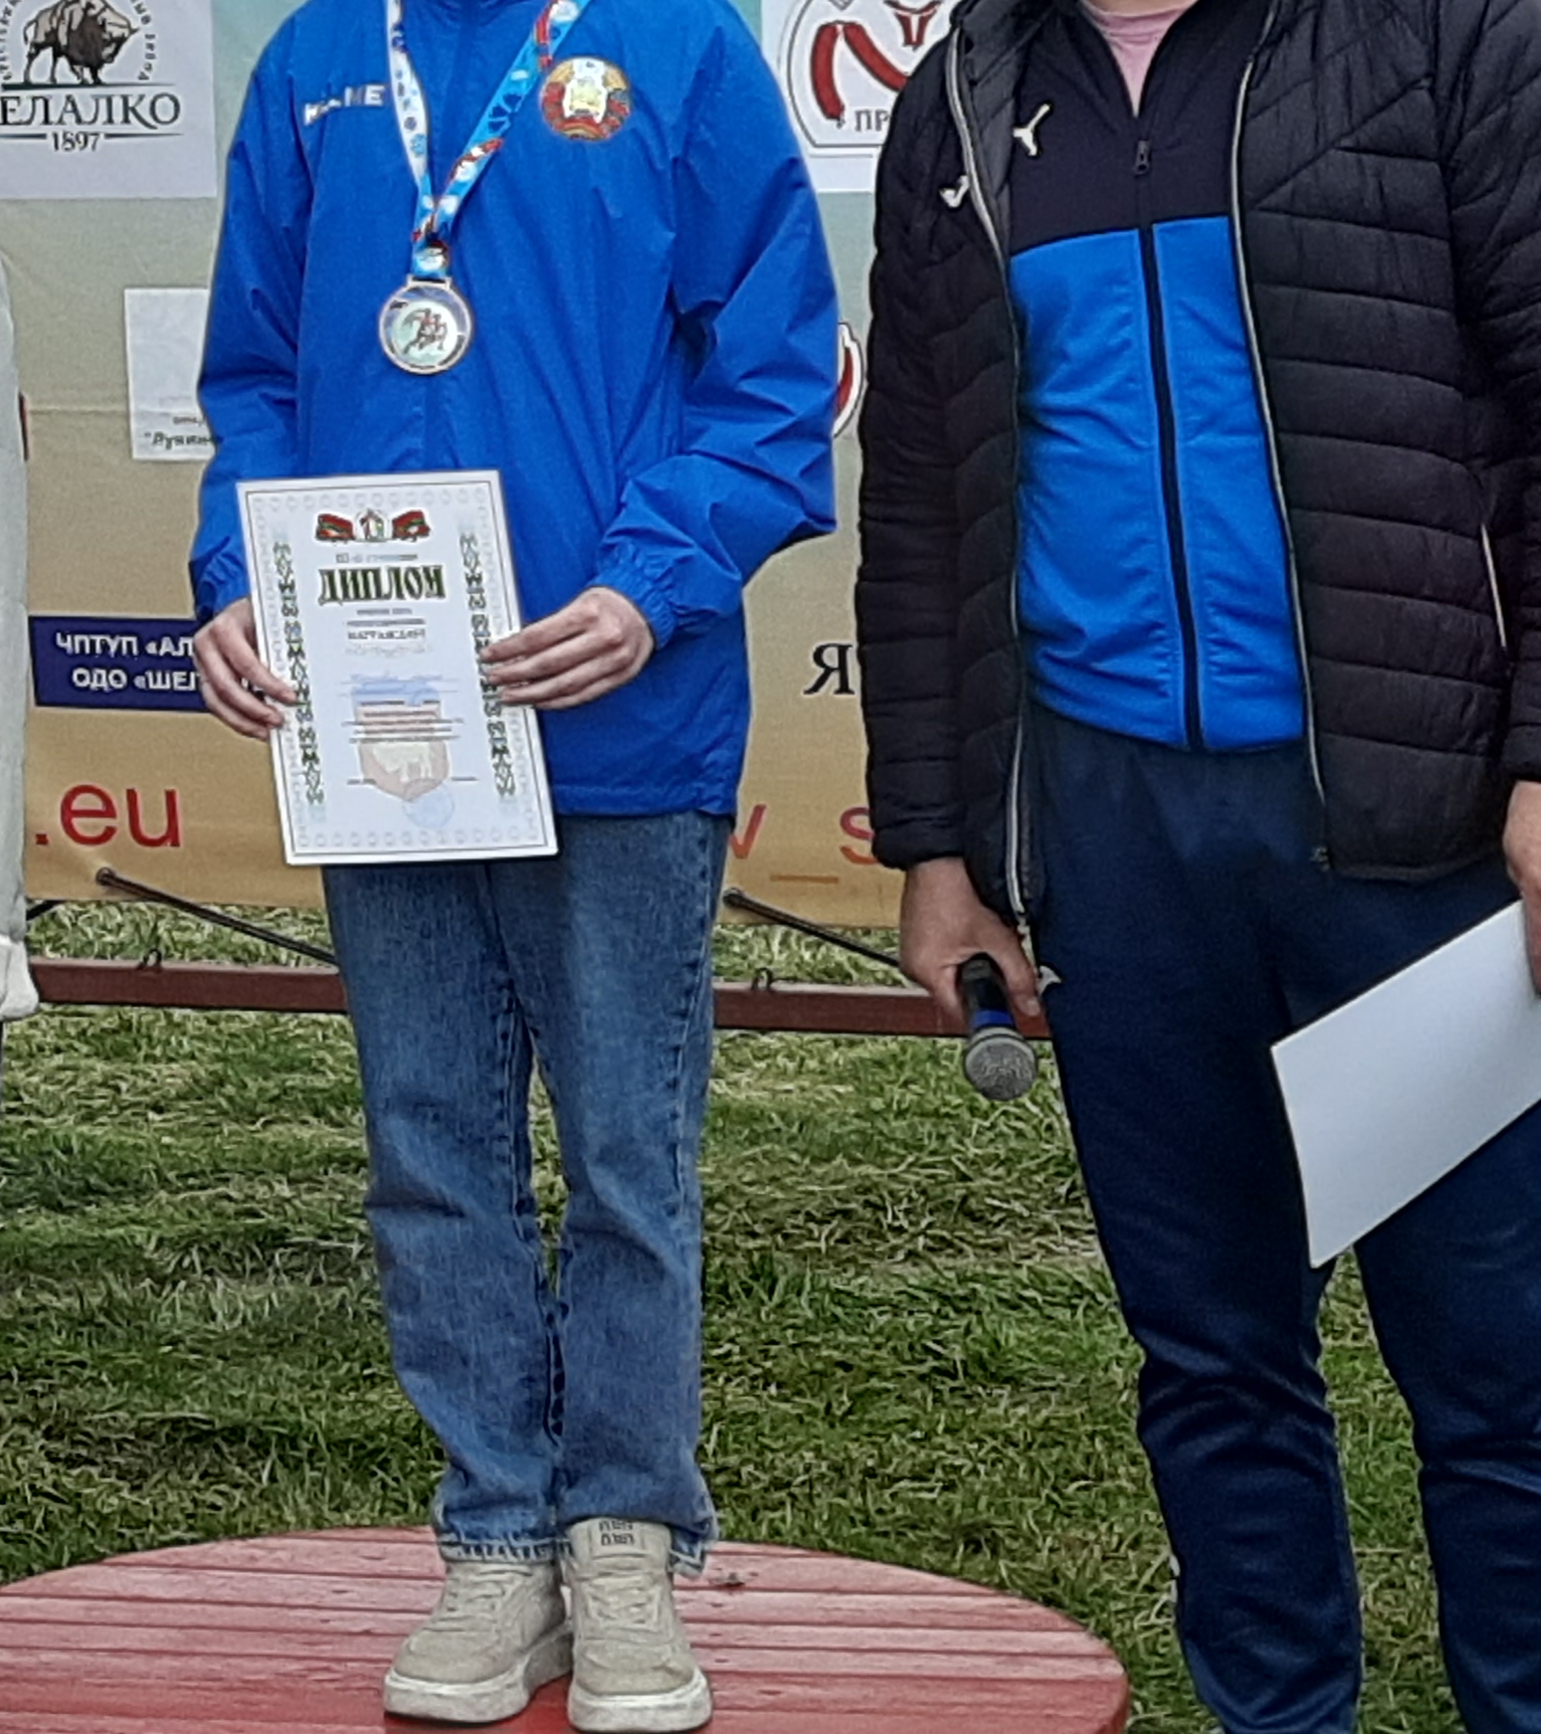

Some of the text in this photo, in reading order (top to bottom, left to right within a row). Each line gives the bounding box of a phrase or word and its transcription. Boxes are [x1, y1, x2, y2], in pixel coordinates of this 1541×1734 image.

[51, 131, 100, 152] 1897
[318, 564, 446, 605] ДИПЛОМ
[56, 632, 138, 657] ЧПТУП
[72, 667, 128, 691] ОДО
